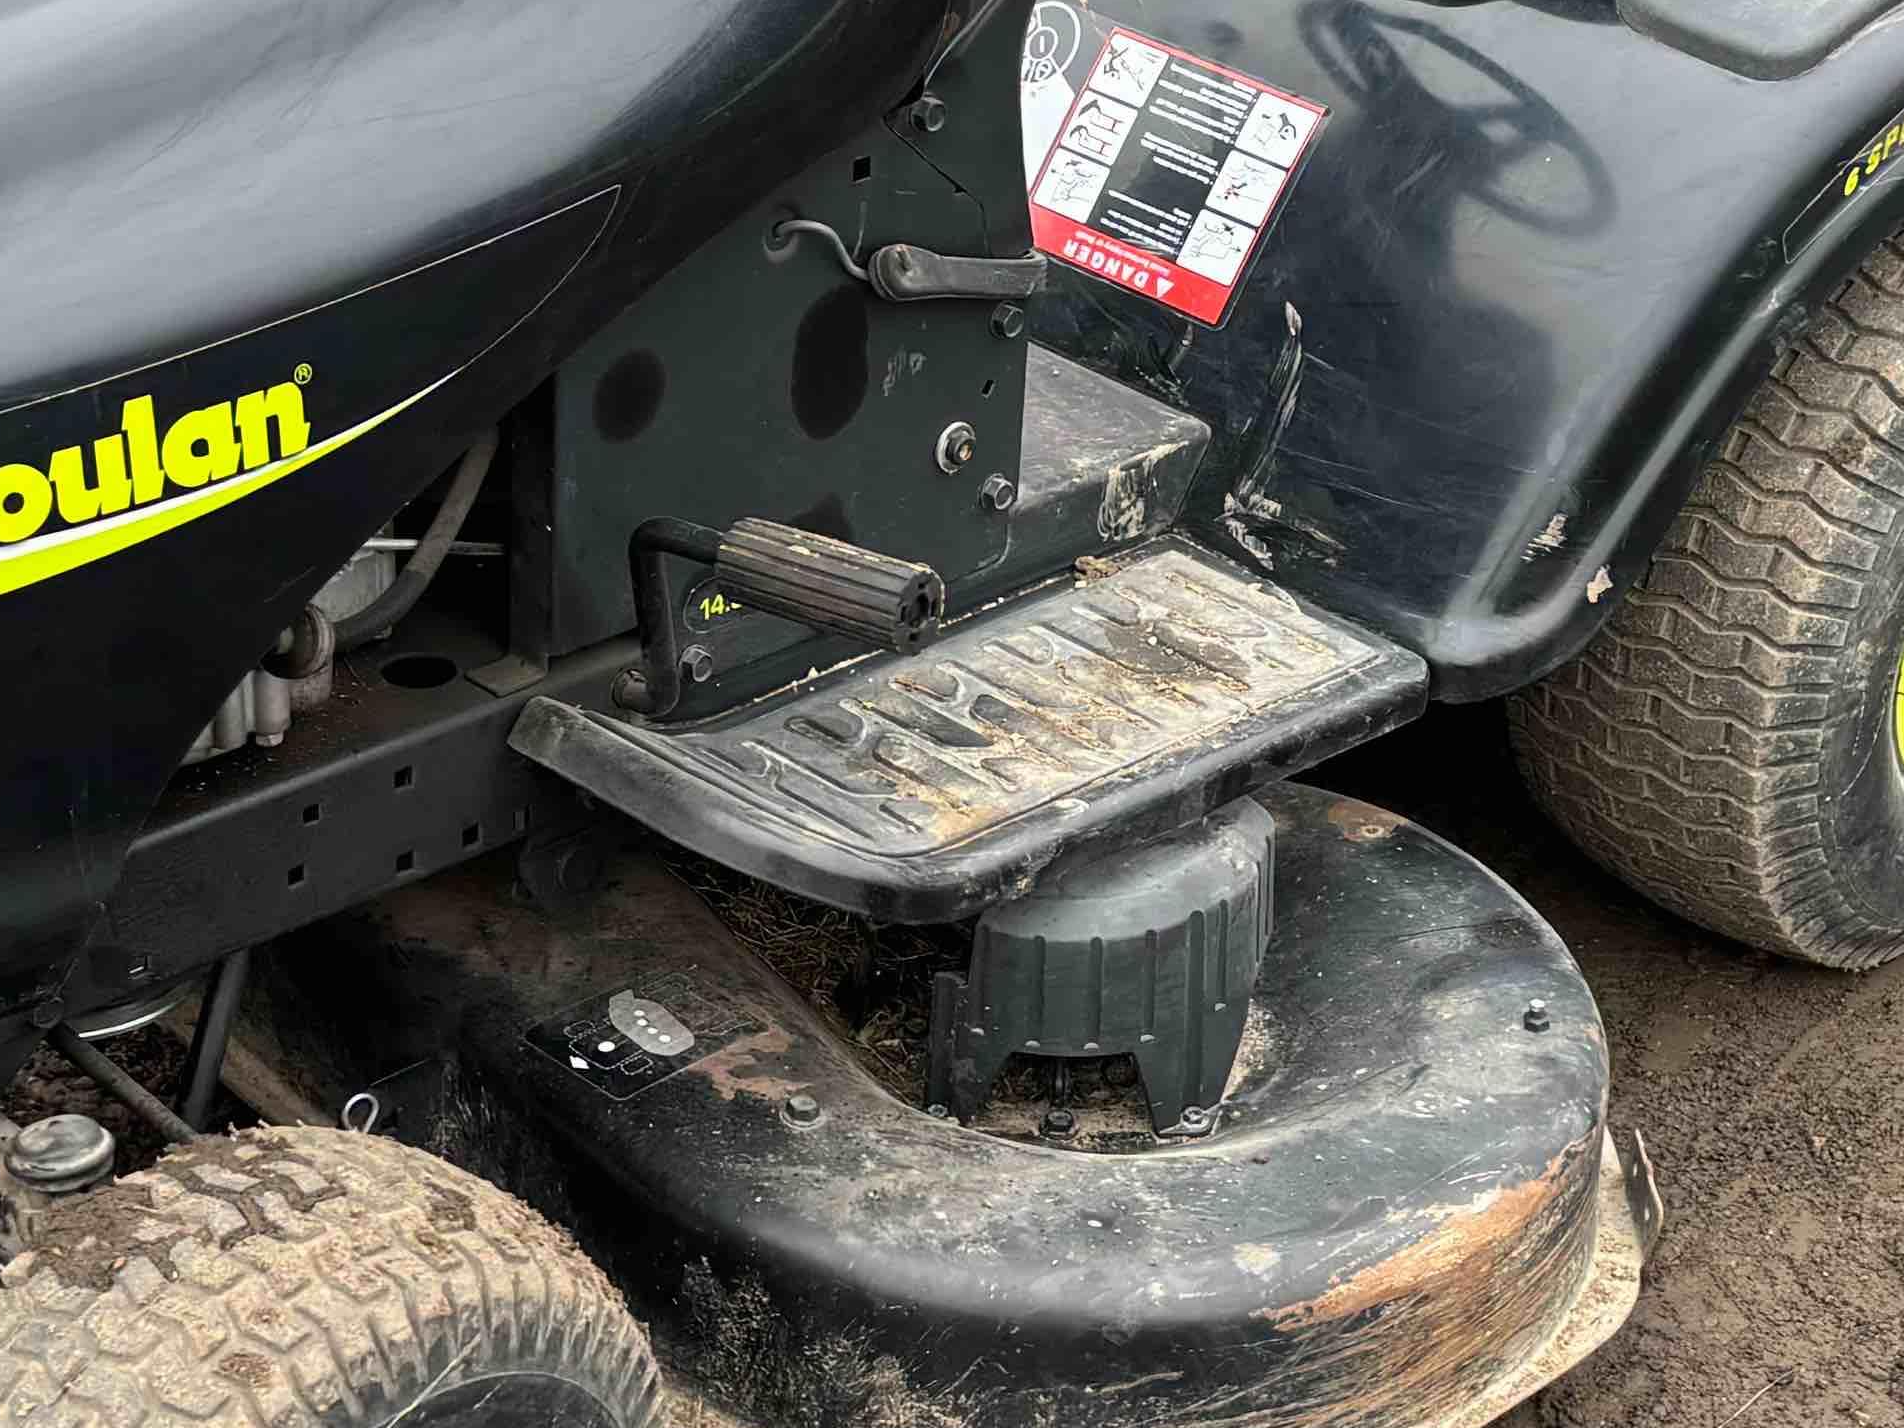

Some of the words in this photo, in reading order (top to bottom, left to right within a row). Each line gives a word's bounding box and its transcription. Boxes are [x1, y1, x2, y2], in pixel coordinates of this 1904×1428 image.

[1843, 166, 1861, 197] 6
[1063, 238, 1151, 290] DANGER
[698, 593, 743, 621] 14.
